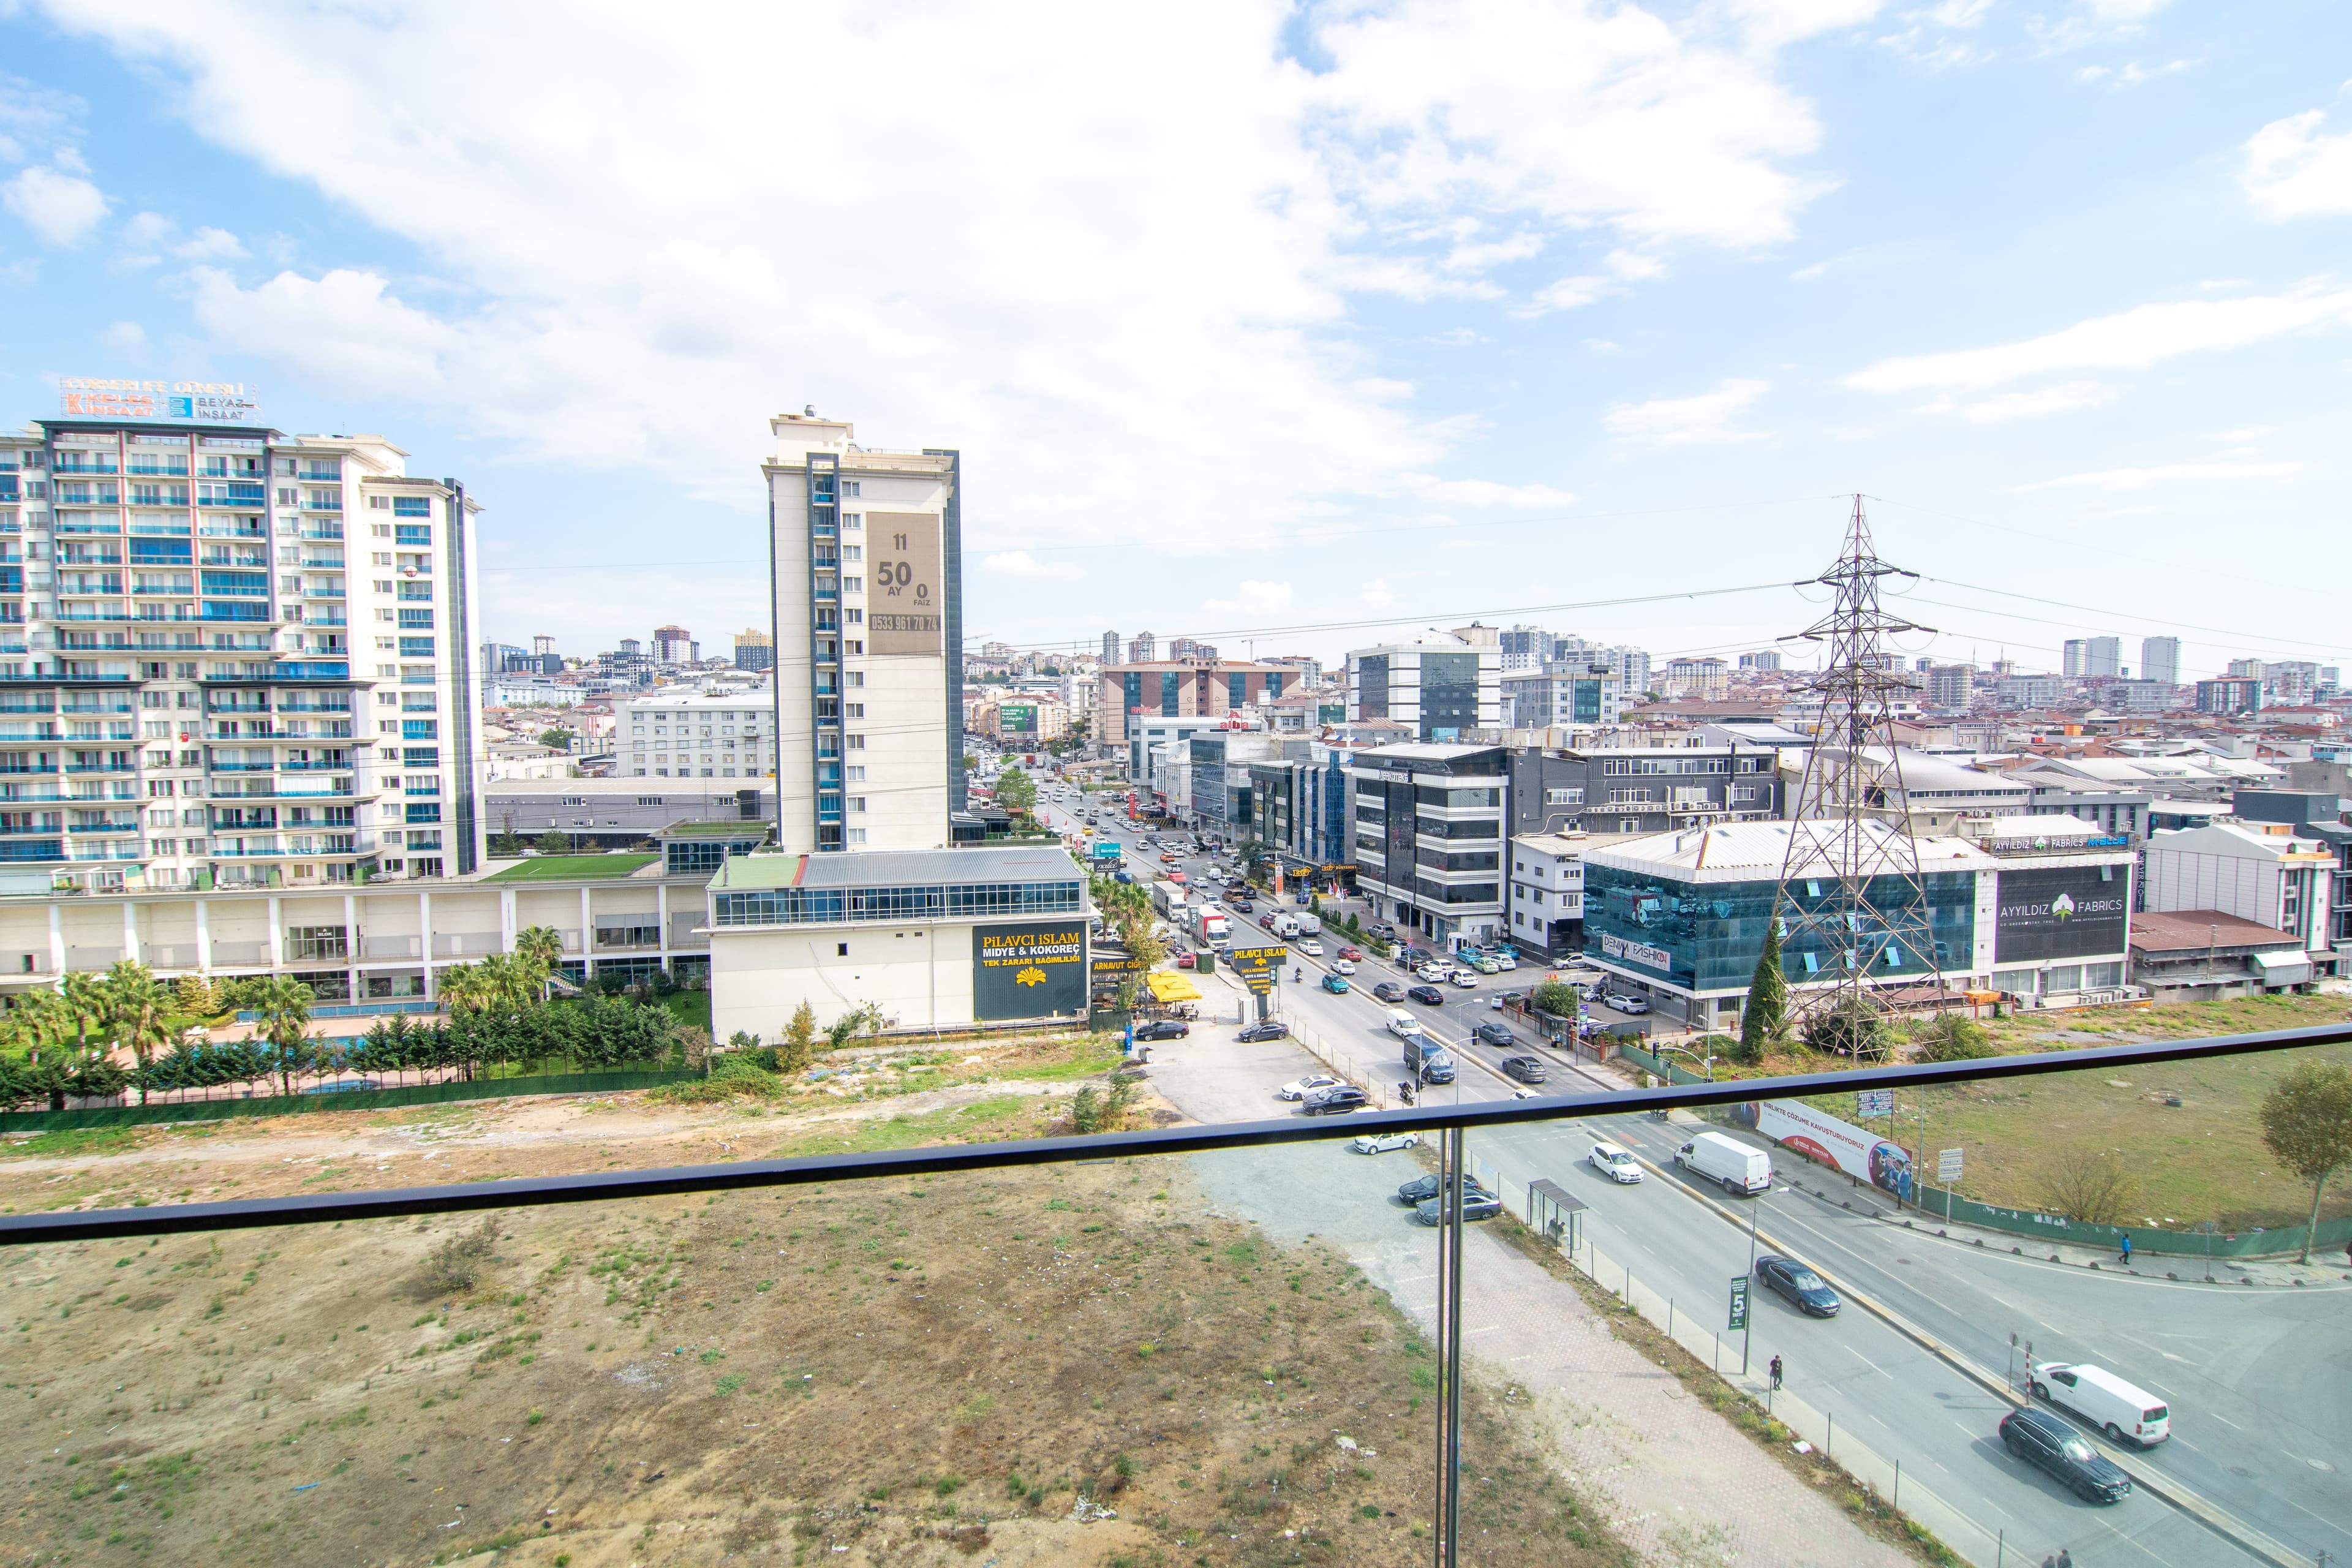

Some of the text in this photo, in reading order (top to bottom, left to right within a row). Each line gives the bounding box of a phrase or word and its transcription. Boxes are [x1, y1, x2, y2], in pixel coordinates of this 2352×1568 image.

[198, 398, 244, 408] BEYAZ
[198, 407, 244, 420] İNŞAAT
[893, 533, 907, 550] 11
[878, 562, 912, 586] 50
[888, 587, 902, 596] AY
[916, 584, 928, 598] 0
[872, 616, 937, 630] 0533 961 70 74
[1219, 720, 1250, 729] alba
[1995, 839, 2083, 850] AYYILDIZ FABRICS
[2000, 899, 2122, 918] AYYILDIZ FABRICS
[1019, 946, 1027, 956] &
[1030, 944, 1080, 955] KOKOREÇ
[1604, 936, 1629, 952] DENIM
[1035, 955, 1080, 964] BAĞIMLILIĞI
[1094, 962, 1125, 970] ARNAVUT
[1811, 1121, 1864, 1150] KAVUŞTURUYORUZ
[1733, 1294, 1745, 1313] 5
